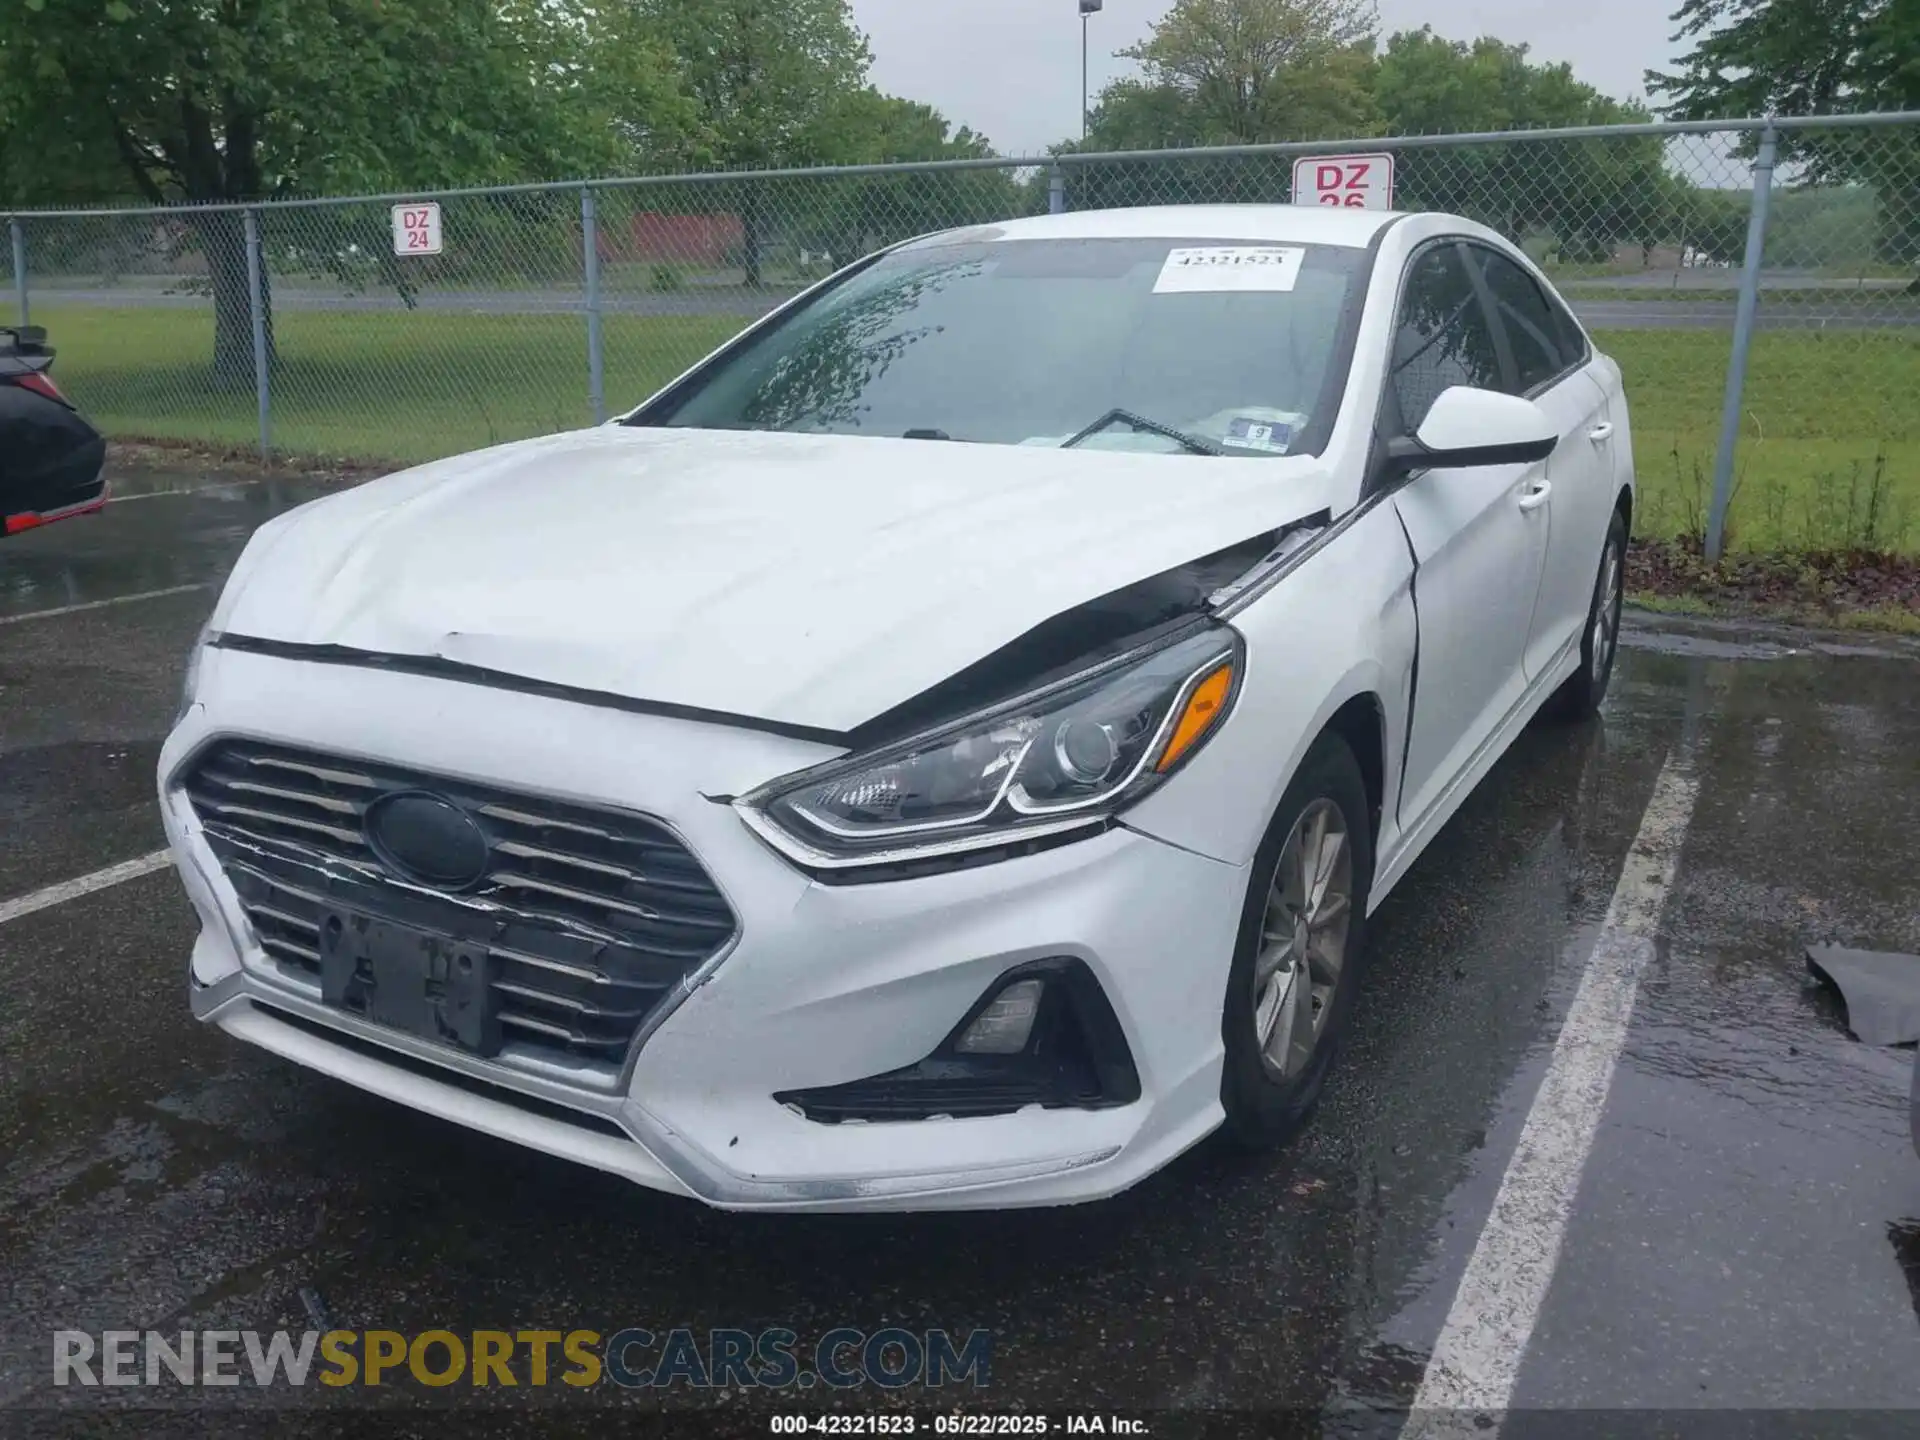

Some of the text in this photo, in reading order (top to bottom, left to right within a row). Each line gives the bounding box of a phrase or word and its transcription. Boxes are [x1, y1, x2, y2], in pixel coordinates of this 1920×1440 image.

[1317, 163, 1370, 190] DZ
[404, 209, 430, 229] DZ
[408, 230, 429, 249] 24
